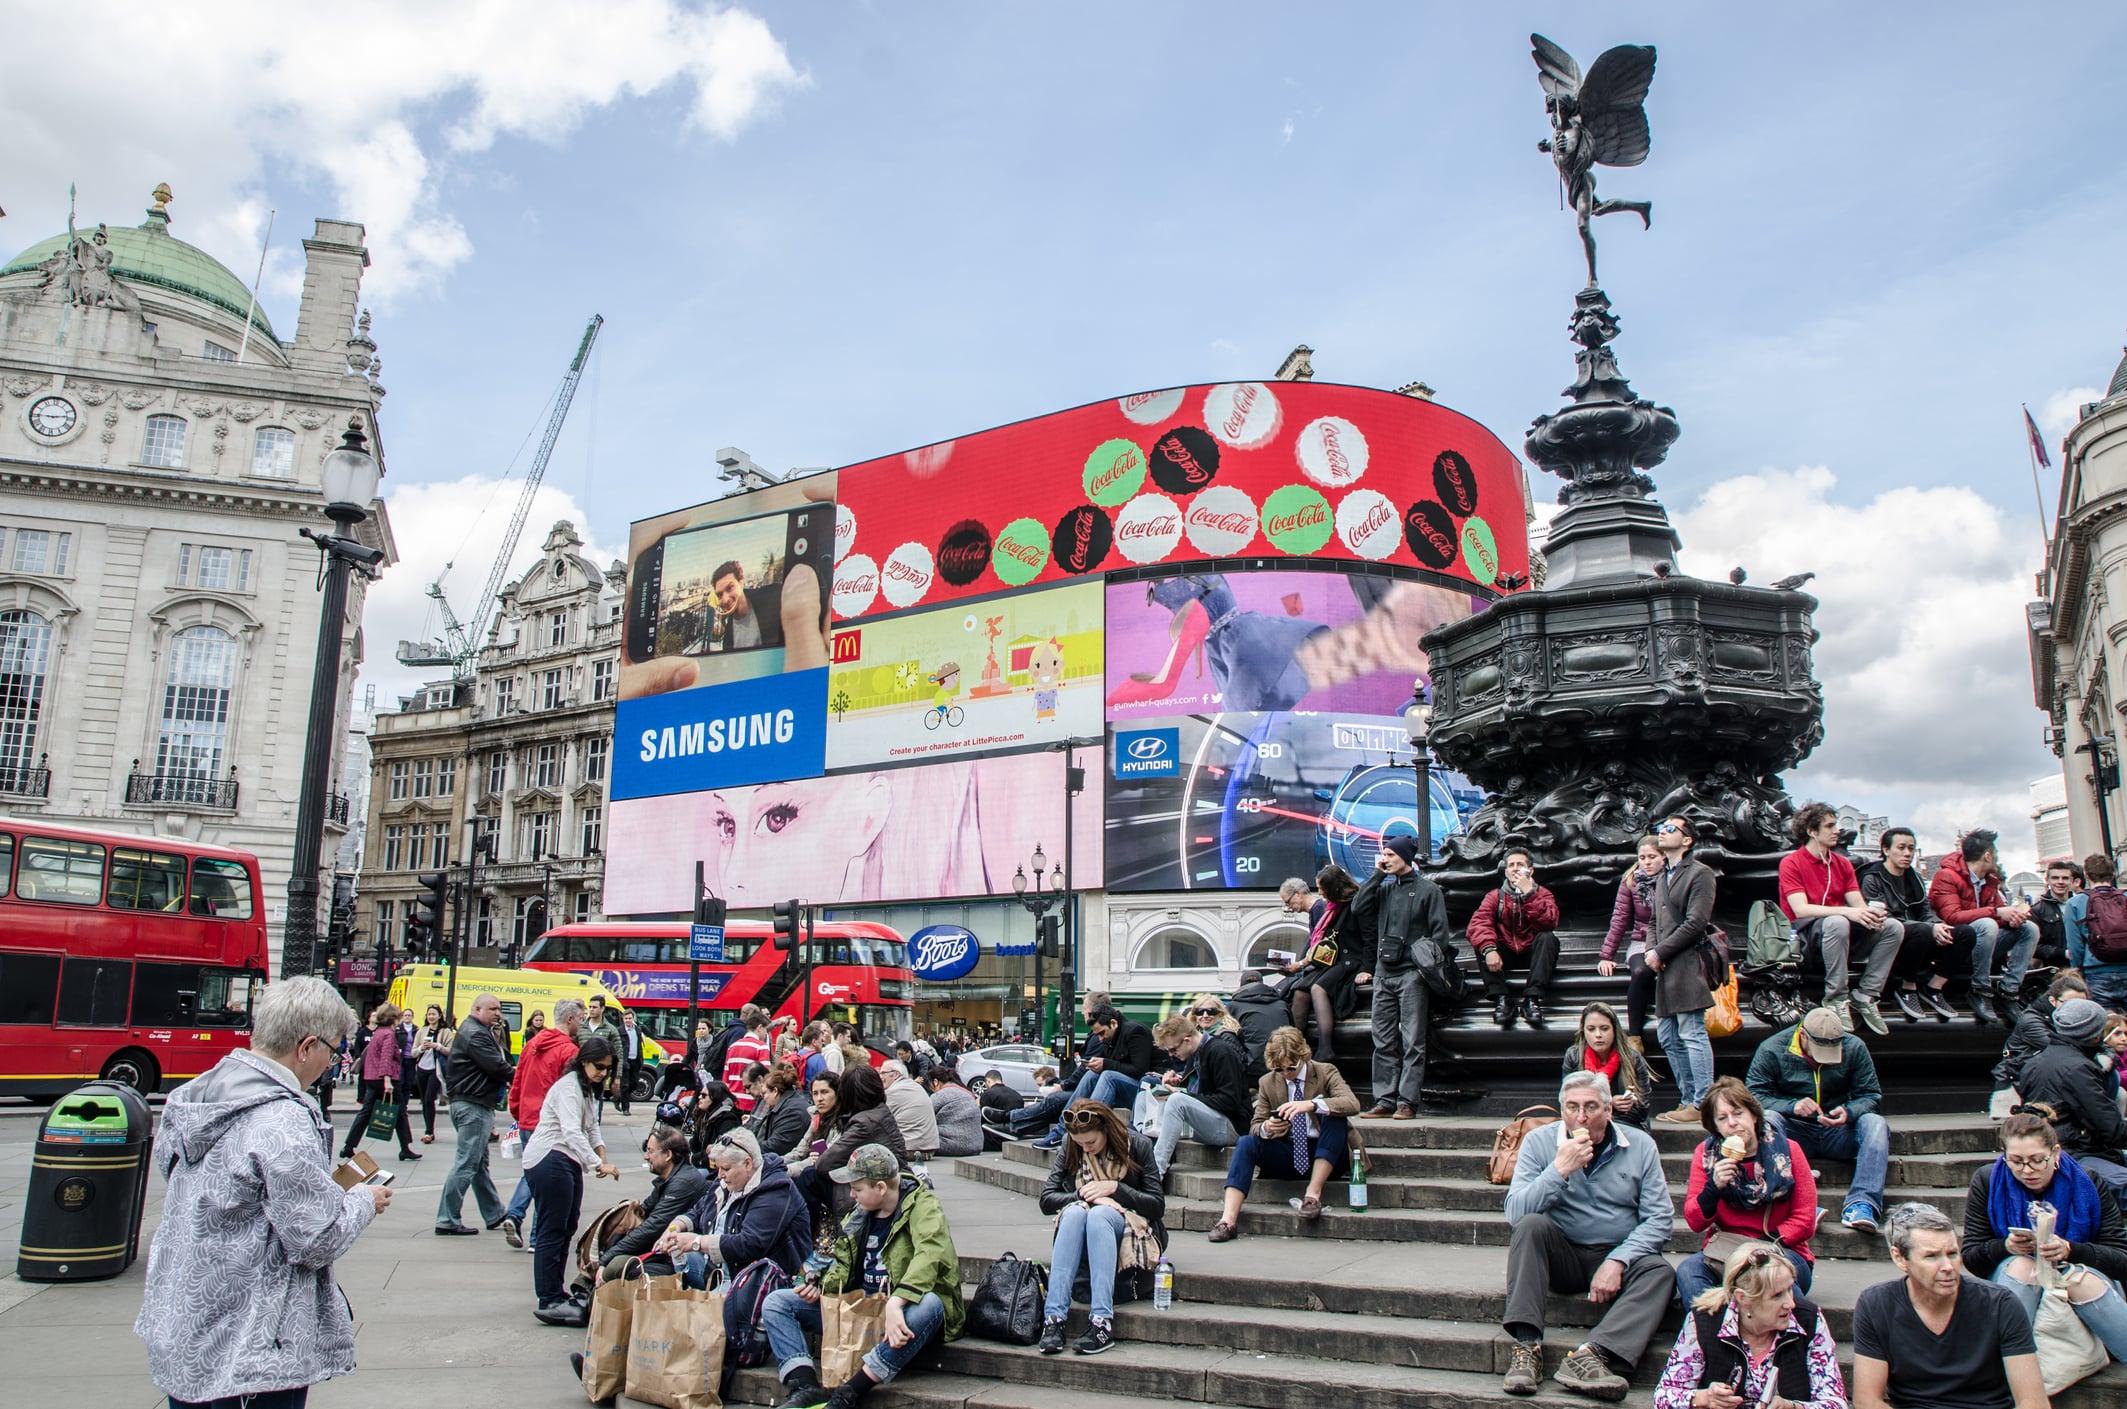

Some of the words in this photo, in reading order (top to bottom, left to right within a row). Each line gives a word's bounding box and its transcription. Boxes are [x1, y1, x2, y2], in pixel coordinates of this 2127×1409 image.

[1090, 446, 1141, 496] Coca-Cola
[1190, 507, 1257, 536] Coca-Cola
[1268, 502, 1328, 536] Coca-Cola
[1348, 498, 1394, 548] Coca-Cola
[1119, 515, 1179, 541] Coca-Cola
[998, 536, 1048, 568] Coca-Cola
[1113, 696, 1198, 712] gunwharf-quays.com
[640, 708, 794, 762] SAMSUNG
[889, 746, 912, 756] Create
[913, 745, 928, 754] your
[929, 741, 962, 751] character
[963, 739, 971, 747] at
[1257, 743, 1282, 758] 60
[1122, 760, 1173, 773] HYUNDAI
[1236, 798, 1262, 813] 40
[1235, 857, 1261, 872] 20
[911, 934, 969, 971] Boots
[996, 941, 1036, 957] beaut
[456, 983, 504, 993] EMERGENCY
[505, 986, 553, 996] AMBULANCE
[648, 983, 678, 992] OPENS
[700, 985, 721, 993] MAY
